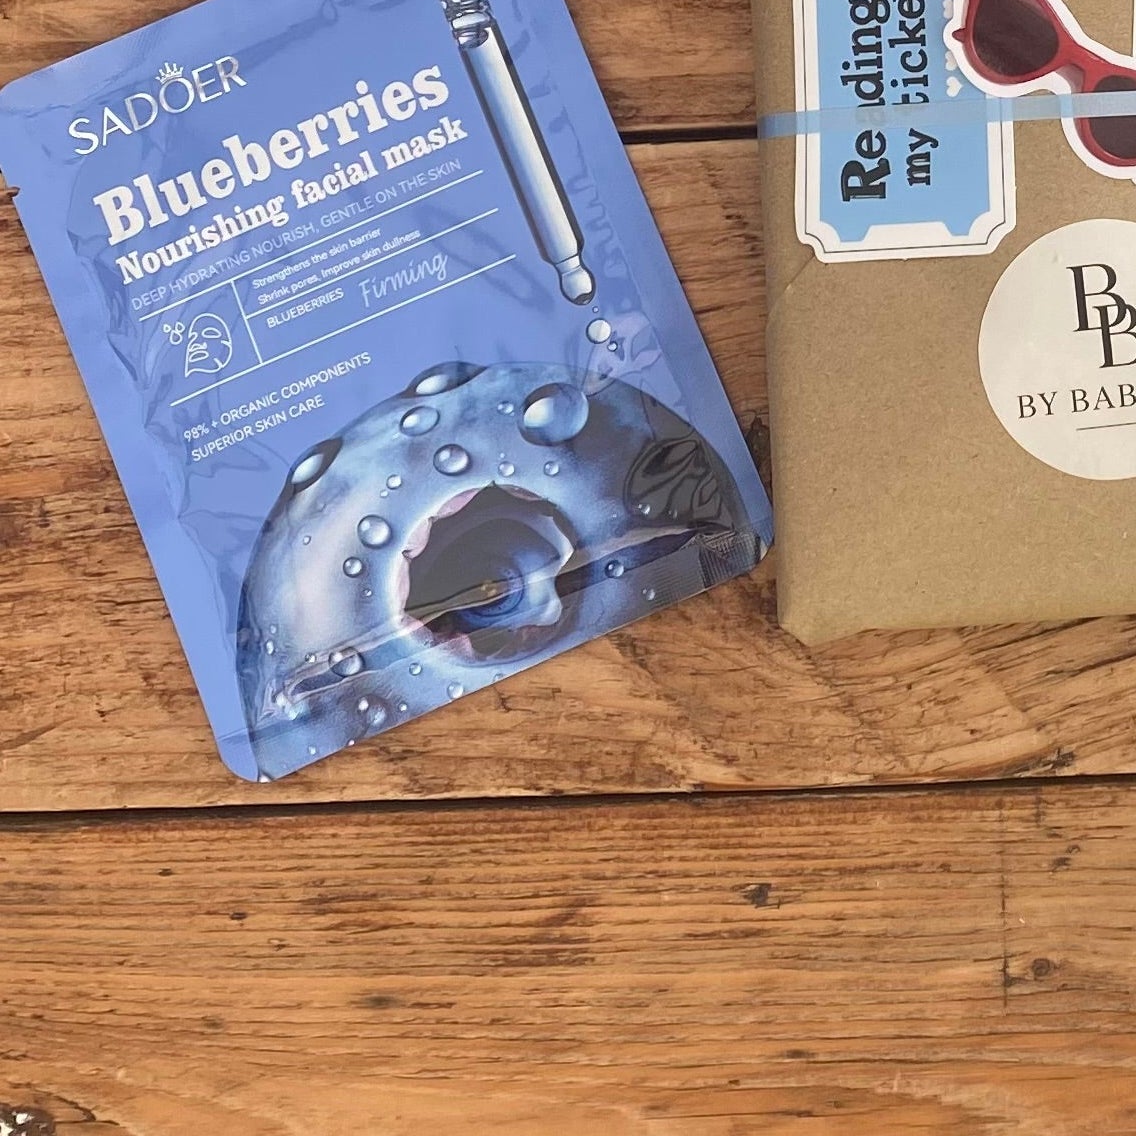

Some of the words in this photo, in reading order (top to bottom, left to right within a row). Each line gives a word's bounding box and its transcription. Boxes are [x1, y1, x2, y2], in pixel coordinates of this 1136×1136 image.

[68, 56, 247, 155] SADOER
[94, 64, 449, 245] Blueberries
[906, 128, 939, 186] my
[115, 194, 289, 285] Nourishing
[291, 152, 378, 209] facial
[382, 115, 468, 169] mask
[131, 285, 167, 311] DEEP
[169, 251, 250, 295] HYDRATING
[251, 223, 319, 259] NOURISH,
[320, 196, 374, 229] GENTLE
[375, 187, 397, 205] ON
[398, 174, 427, 195] THE
[428, 159, 462, 182] SKIN
[252, 258, 311, 289] Strengthens
[311, 250, 328, 263] the
[329, 242, 348, 257] skin
[348, 228, 382, 248] barrier
[258, 286, 290, 305] Shrink
[321, 256, 361, 278] Improve
[361, 246, 382, 263] skin
[382, 230, 421, 252] dullness
[359, 252, 448, 308] Firming
[266, 288, 345, 328] BLUEBERRIES
[184, 423, 210, 443] 98%
[220, 392, 280, 425] ORGANIC
[281, 352, 371, 398] COMPONENTS
[192, 426, 254, 462] SUPERIOR
[255, 411, 287, 433] SKIN
[288, 395, 325, 418] CARE
[1017, 391, 1058, 419] BY
